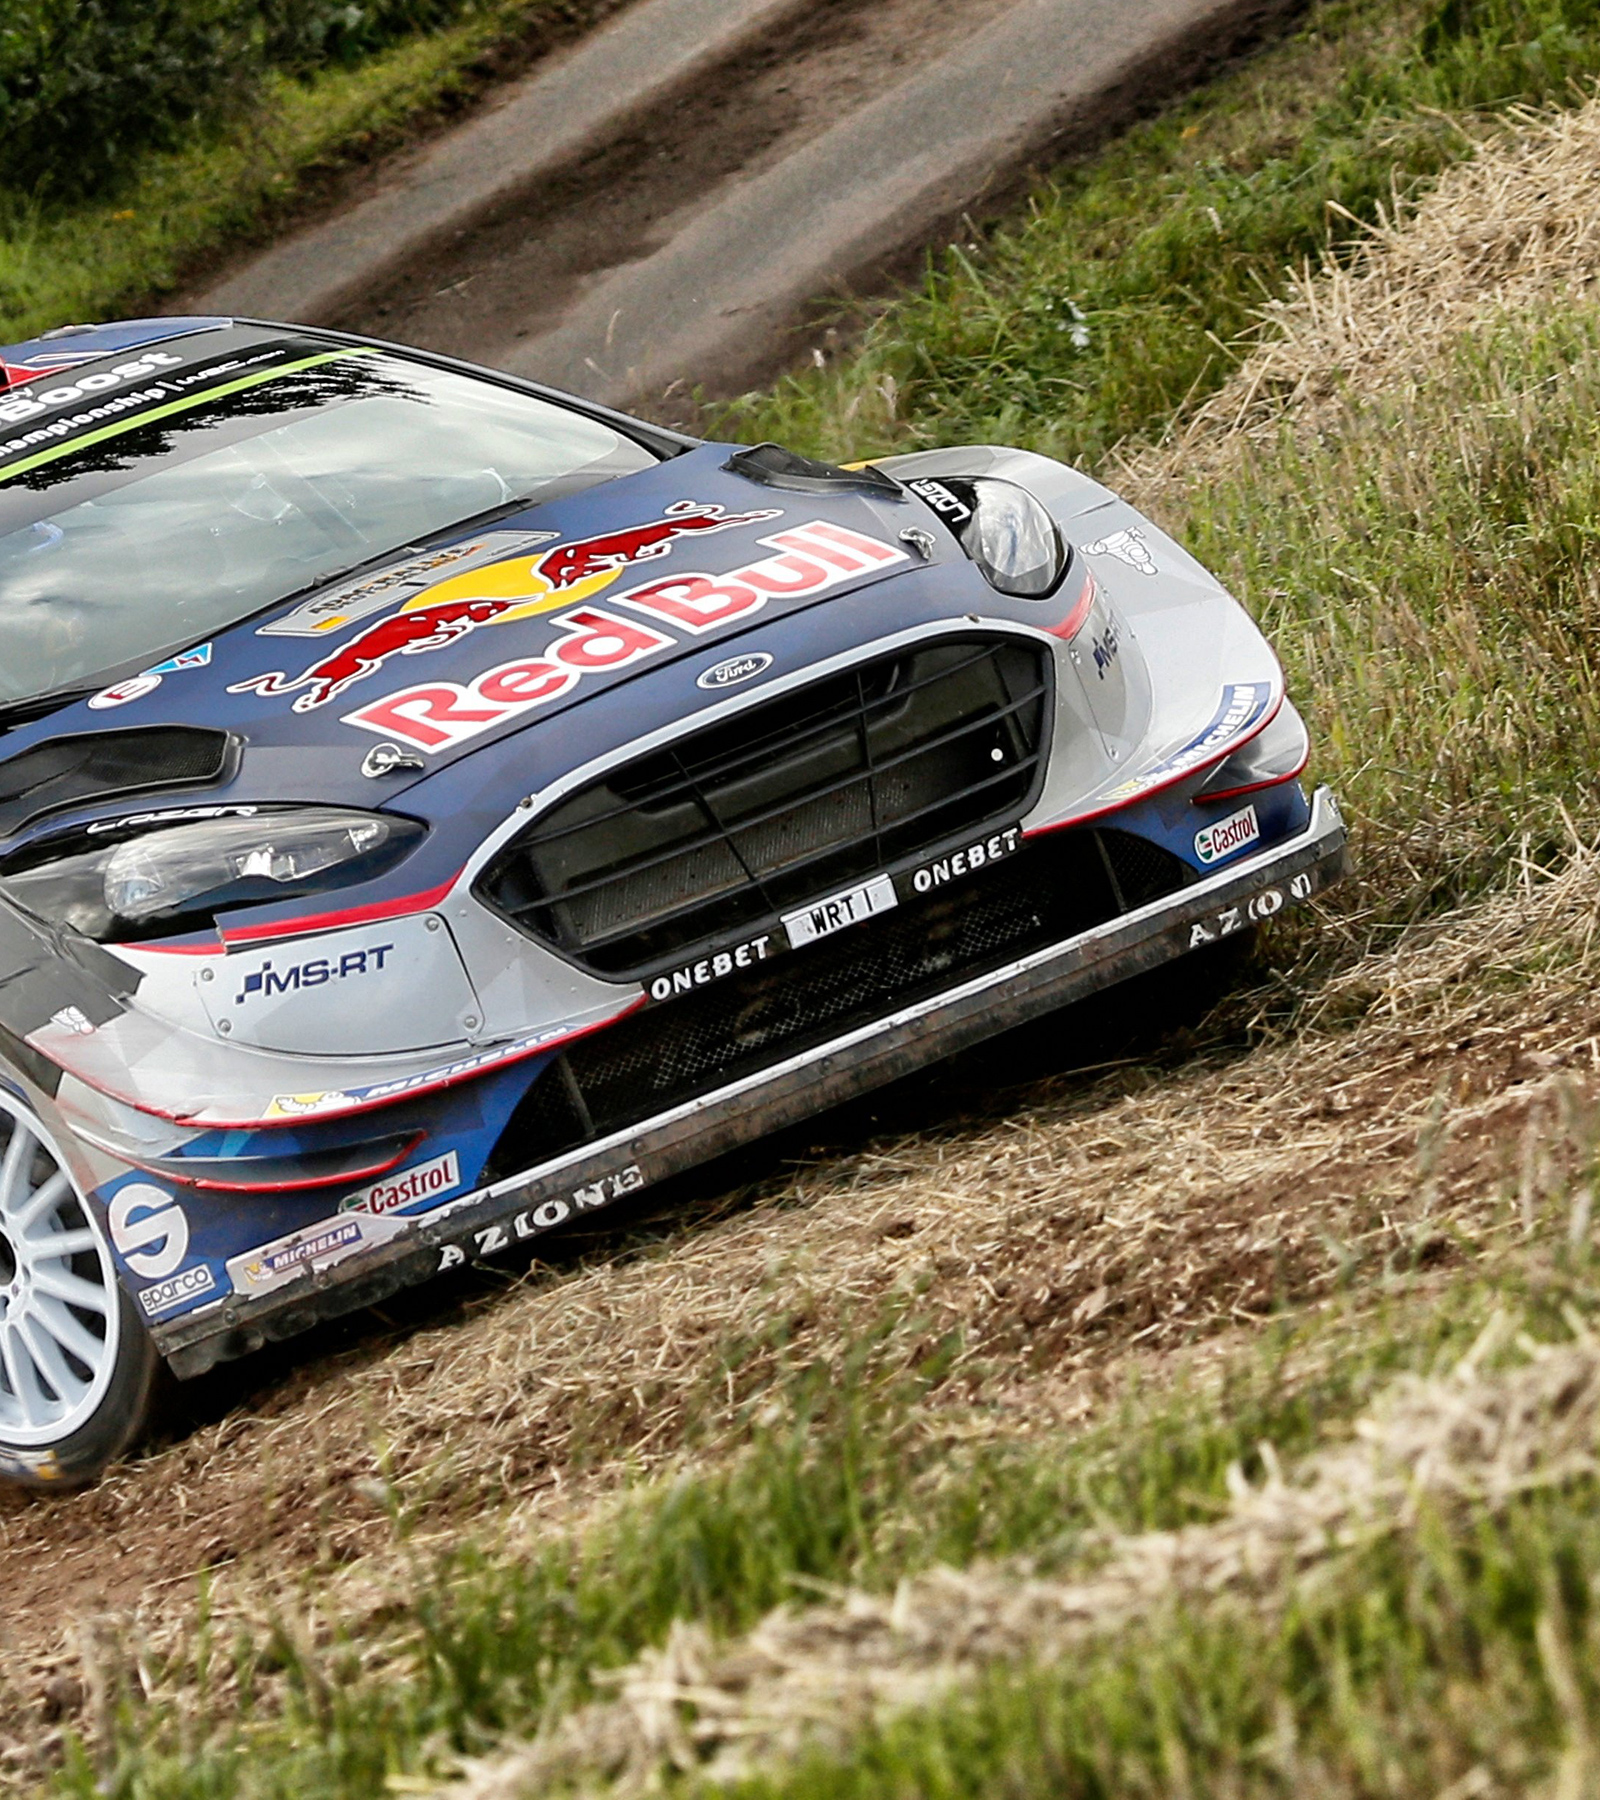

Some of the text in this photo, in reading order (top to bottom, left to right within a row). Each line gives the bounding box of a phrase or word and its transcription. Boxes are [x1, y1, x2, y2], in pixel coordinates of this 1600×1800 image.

[612, 522, 906, 633] Bull
[345, 607, 672, 751] Red
[715, 657, 758, 682] Ford
[1172, 685, 1256, 768] MICHELIN
[913, 827, 1020, 894] ONEBET
[1212, 811, 1256, 853] Castrol
[811, 897, 858, 935] WRT
[264, 943, 395, 997] MS-RT
[651, 936, 770, 1001] ONEBET
[364, 1025, 568, 1099] MICHELIN
[369, 1158, 455, 1217] Castrol
[436, 1165, 645, 1272] AZIONE
[272, 1223, 359, 1271] MICHELIN
[143, 1268, 209, 1311] sparco
